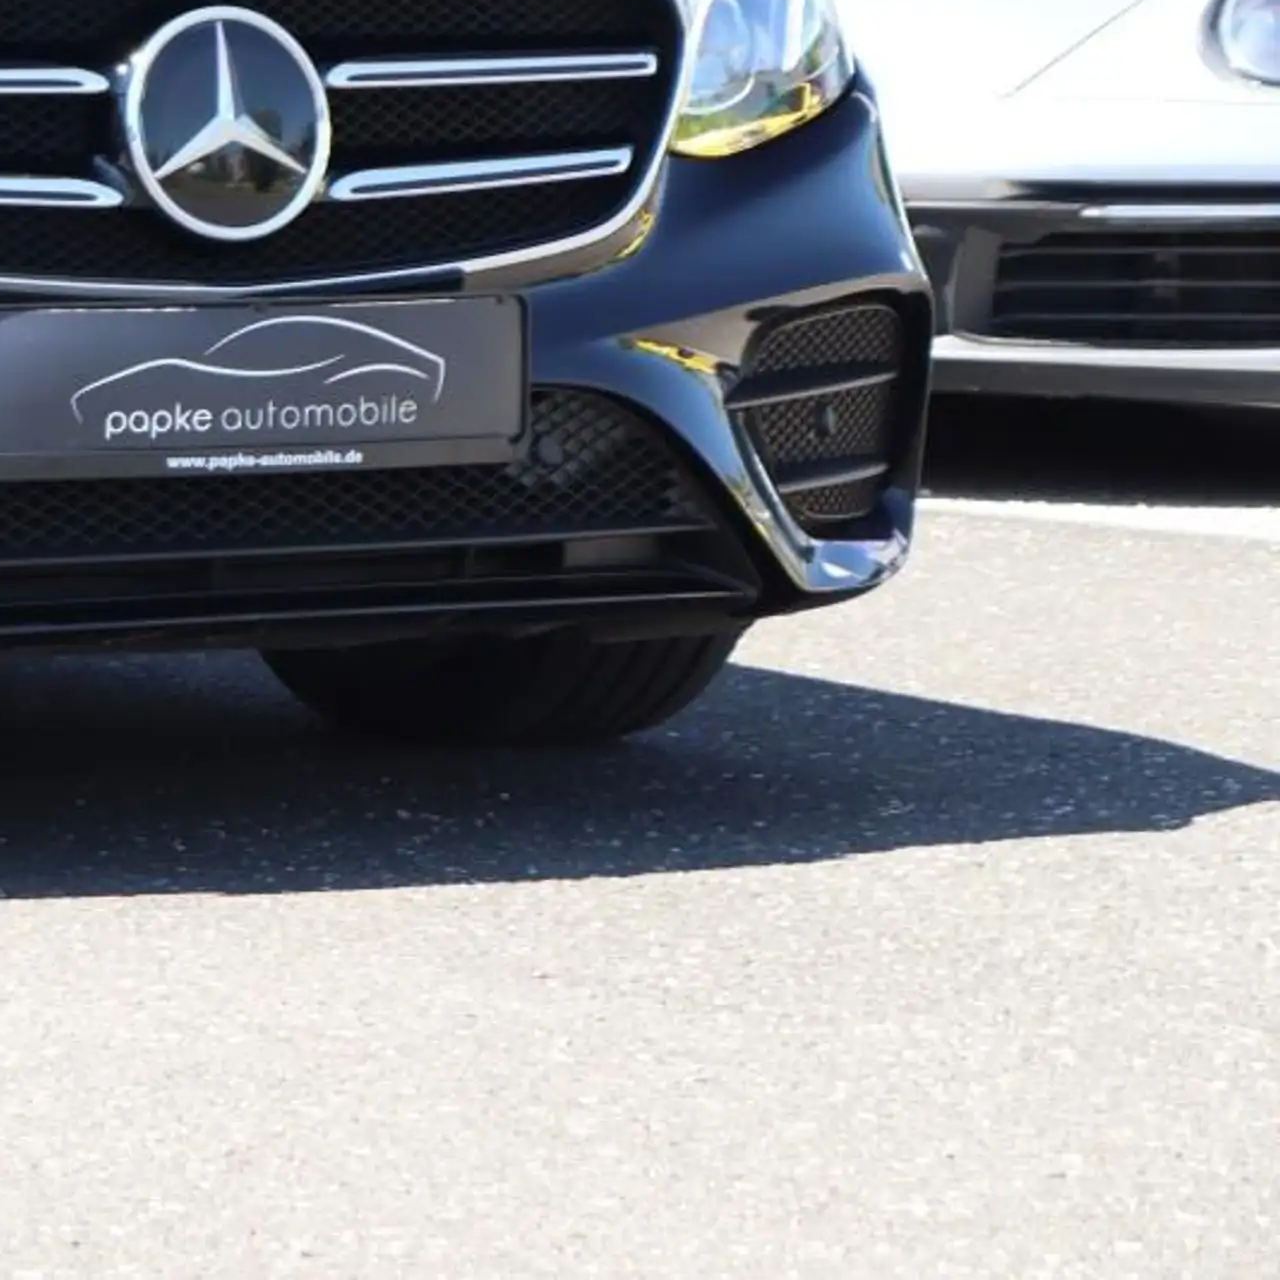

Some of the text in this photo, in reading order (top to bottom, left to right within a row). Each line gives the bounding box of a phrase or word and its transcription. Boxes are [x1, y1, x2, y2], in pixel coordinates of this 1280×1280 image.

[104, 394, 418, 440] papke automobile
[166, 449, 364, 472] www.papke-automobile.de
